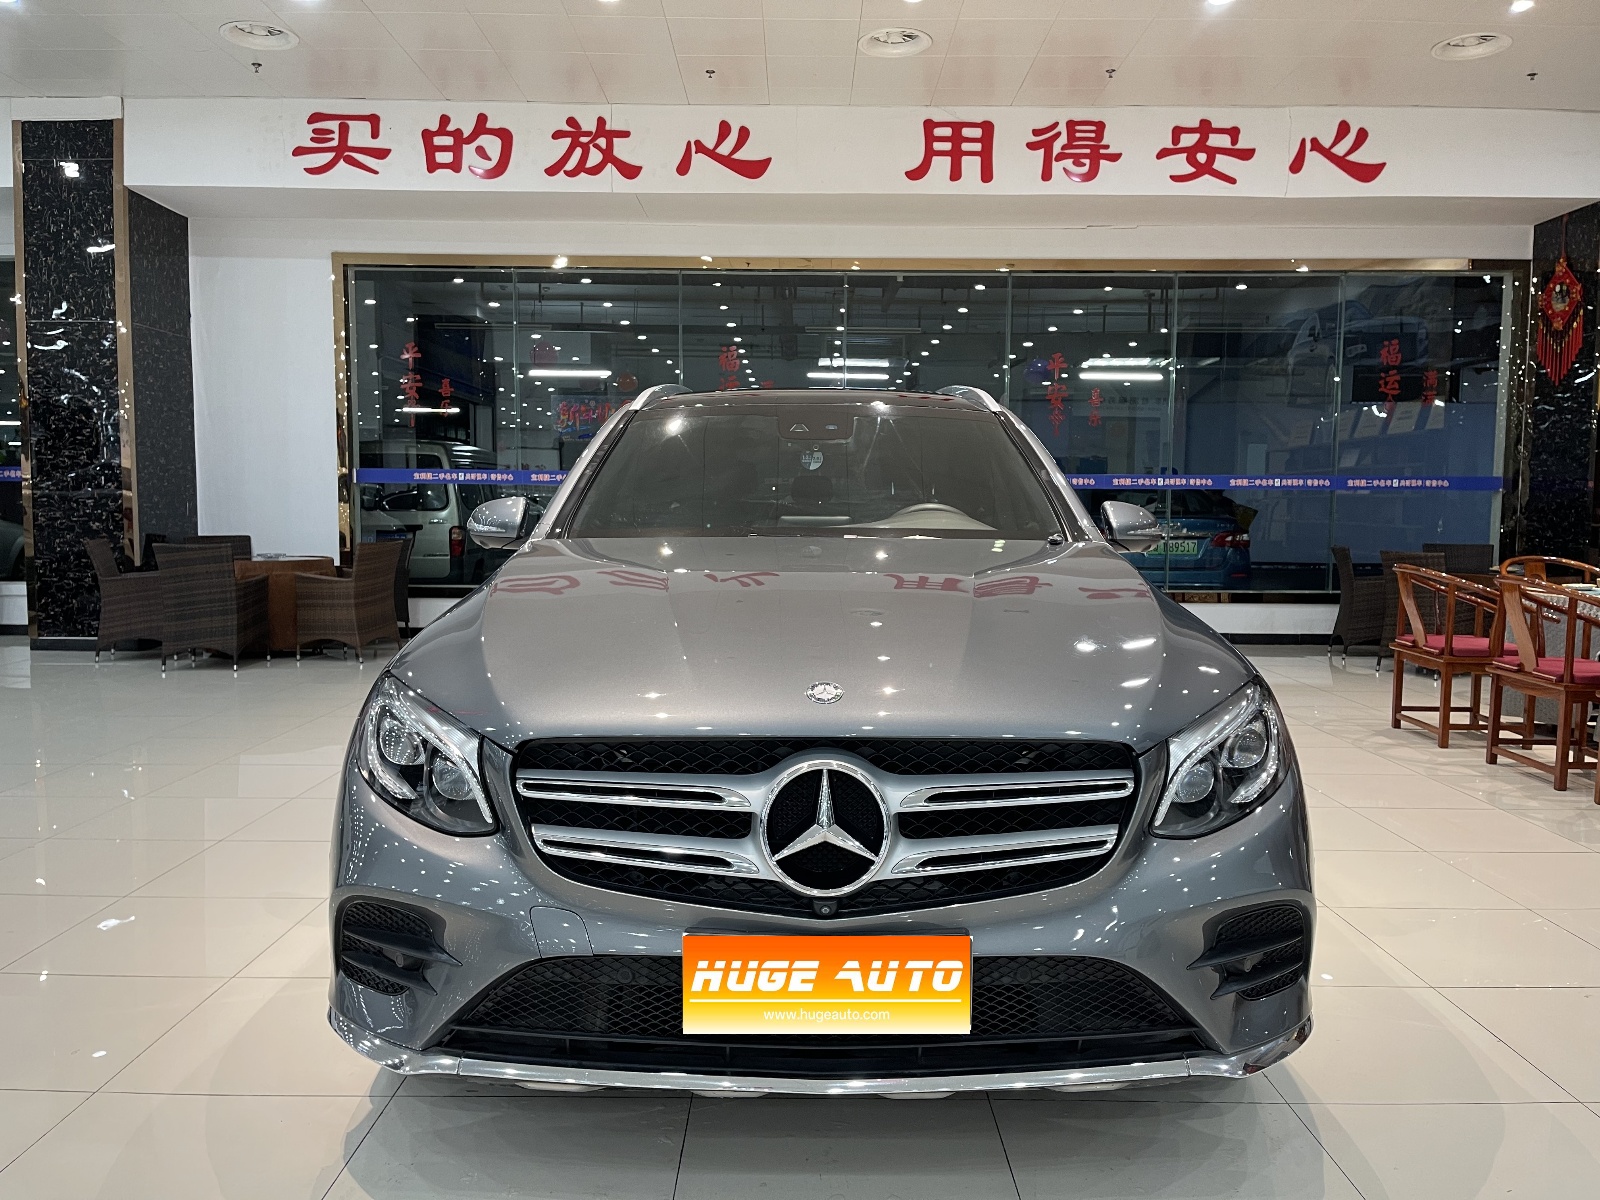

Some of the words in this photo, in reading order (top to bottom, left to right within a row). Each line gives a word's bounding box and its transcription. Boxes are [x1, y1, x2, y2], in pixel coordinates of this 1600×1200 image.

[292, 112, 772, 179] 买的放心
[904, 118, 1387, 184] 用得安心
